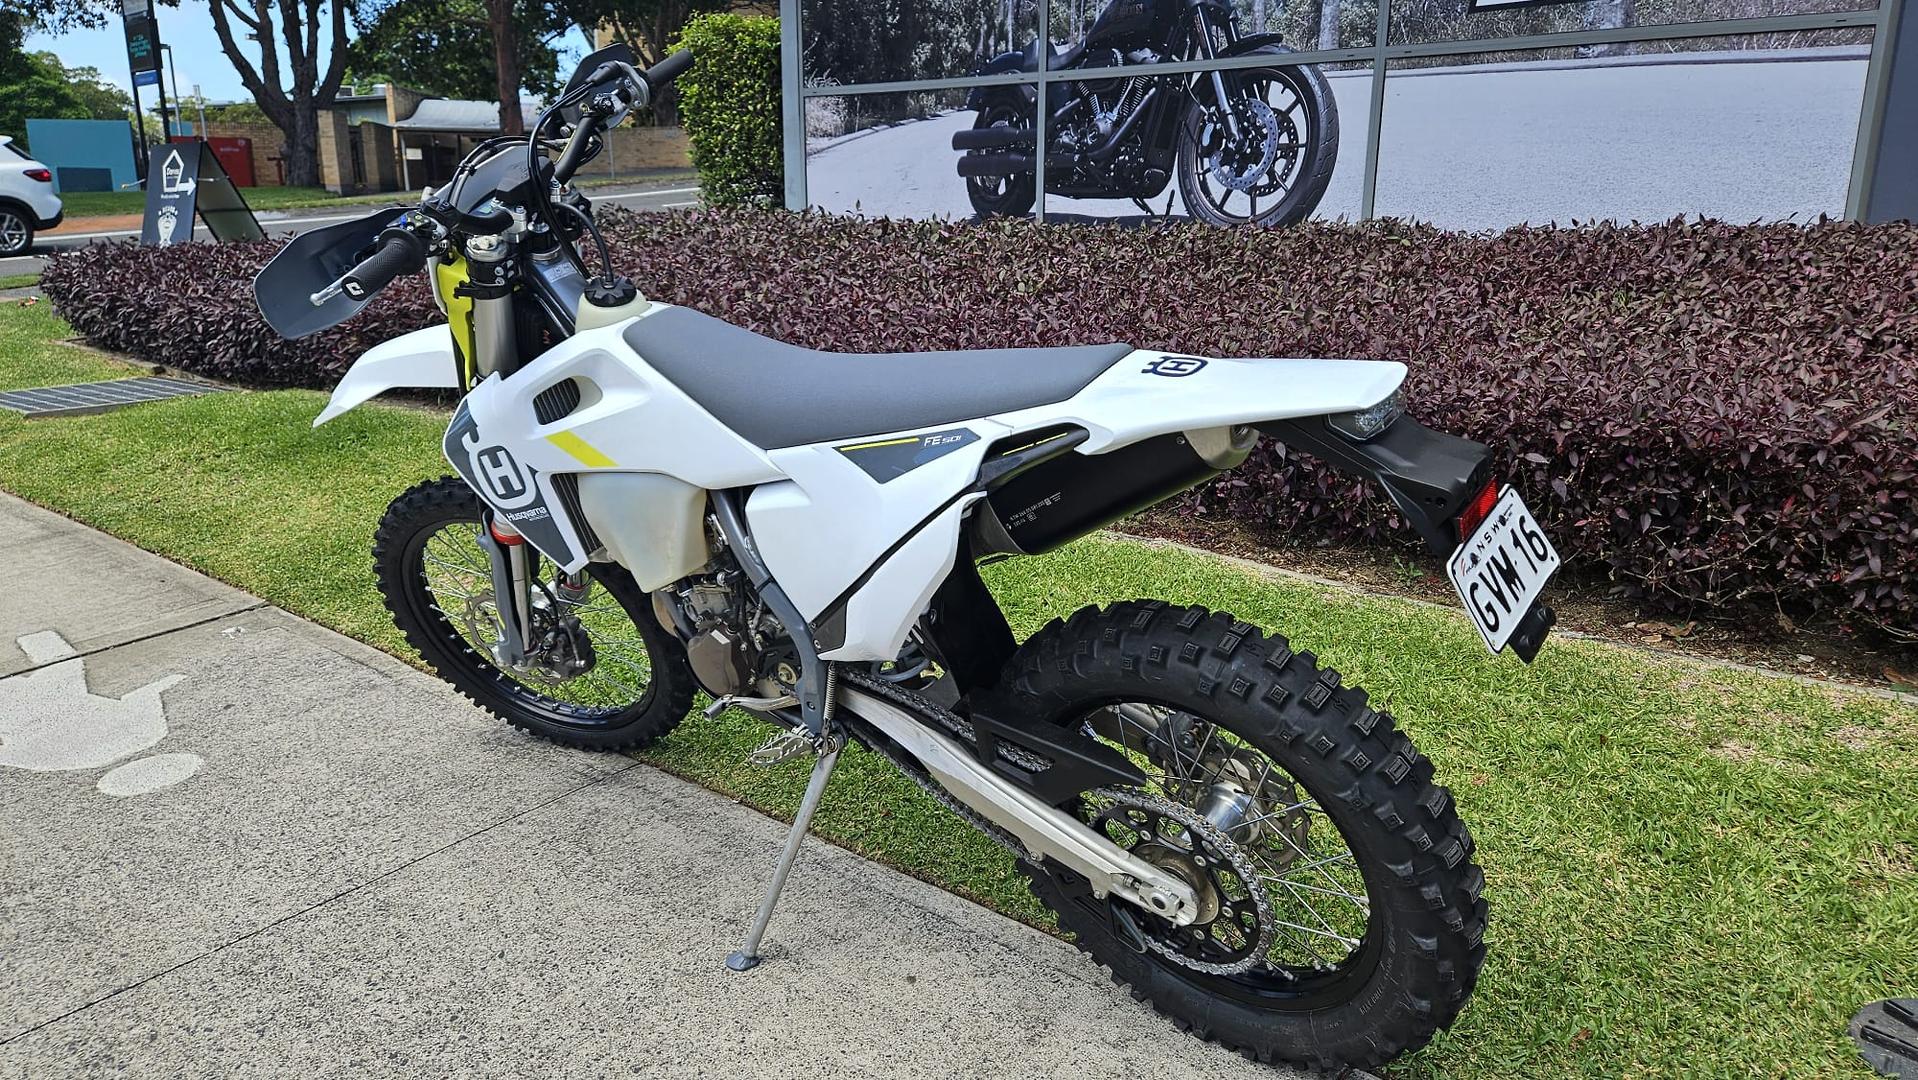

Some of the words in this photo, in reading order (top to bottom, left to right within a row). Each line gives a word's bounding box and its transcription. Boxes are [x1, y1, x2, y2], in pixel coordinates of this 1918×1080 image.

[924, 435, 943, 447] FE
[506, 506, 547, 521] Husqvarna
[1469, 545, 1527, 633] GVM
[1511, 514, 1549, 575] 16
